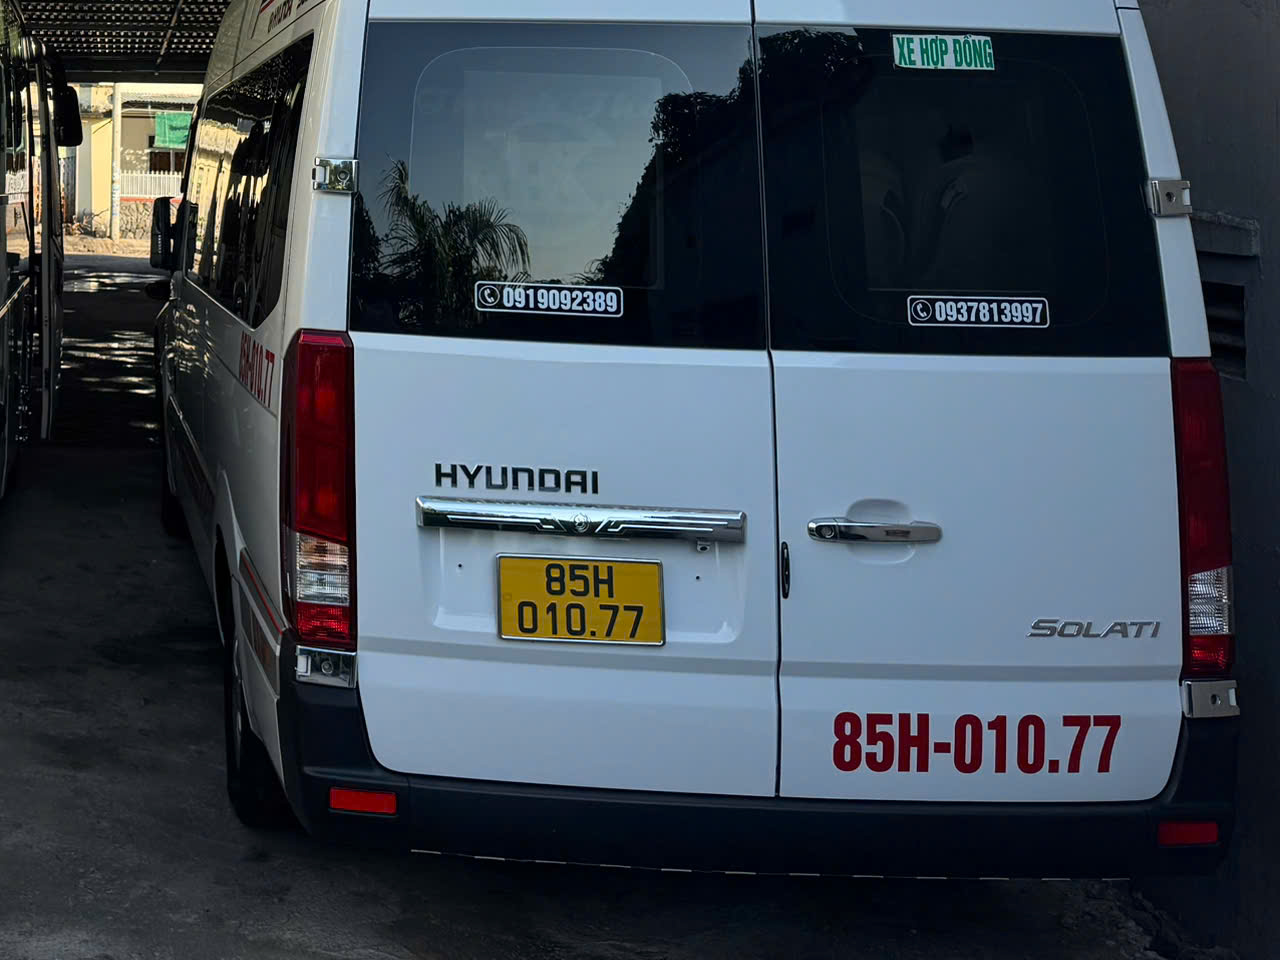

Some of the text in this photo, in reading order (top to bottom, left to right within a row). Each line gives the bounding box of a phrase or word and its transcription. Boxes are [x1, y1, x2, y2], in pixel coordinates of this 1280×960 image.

[896, 34, 994, 69] XE HỢP ĐỒNG
[502, 287, 618, 313] 0919092389
[934, 301, 1043, 323] 0937813997
[434, 463, 600, 494] HYUNDAI
[545, 563, 615, 598] 85H
[517, 601, 644, 639] 010.77
[1026, 618, 1161, 639] SOLATI
[832, 711, 1122, 775] 85H-010.77
